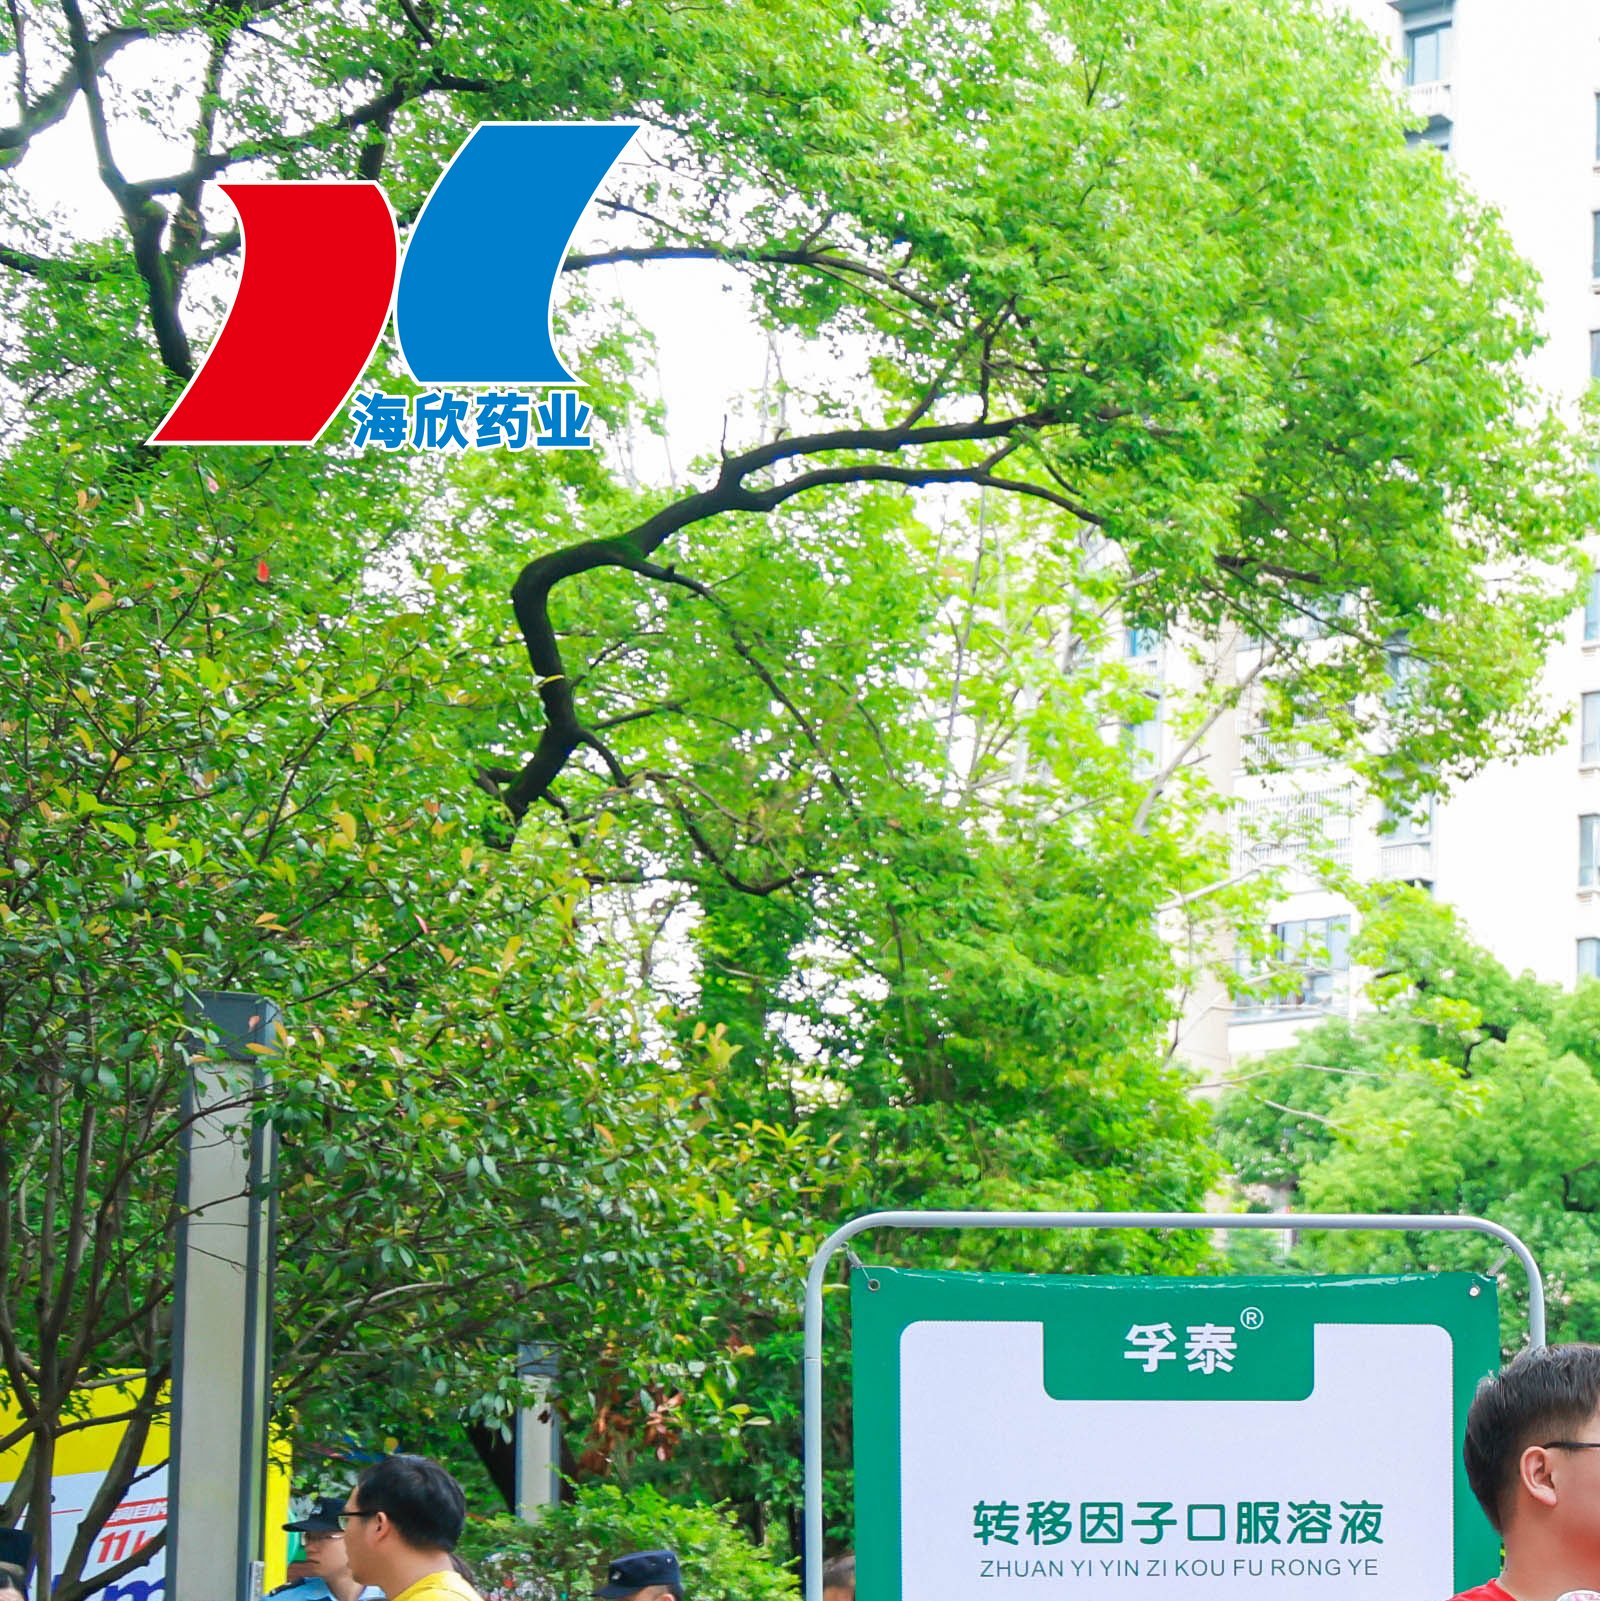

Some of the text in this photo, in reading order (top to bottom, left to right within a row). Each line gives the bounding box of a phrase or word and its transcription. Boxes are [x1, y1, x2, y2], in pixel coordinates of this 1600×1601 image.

[1123, 1321, 1238, 1375] 孚泰
[972, 1499, 1385, 1547] 转移因子口服溶液
[980, 1557, 1379, 1579] ZHUAN YI YIN ZI KOU FU RONG YE
